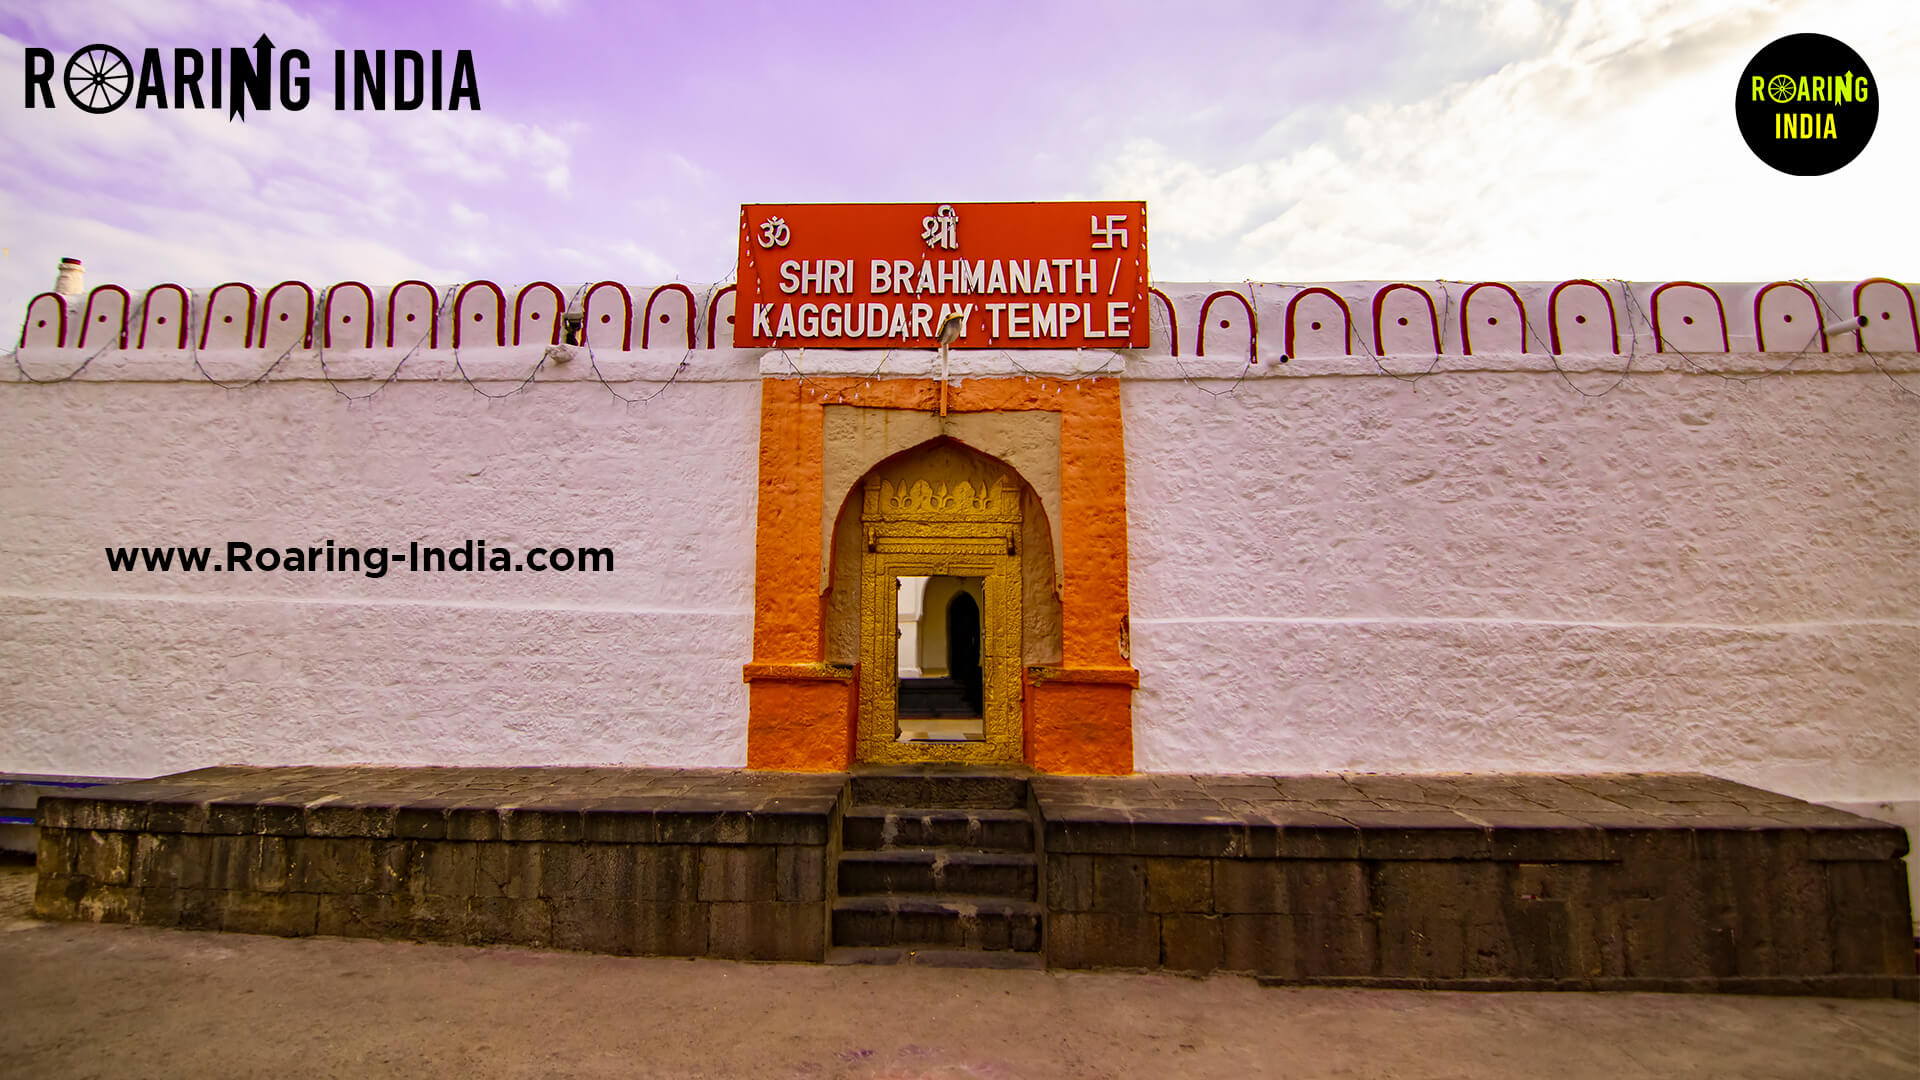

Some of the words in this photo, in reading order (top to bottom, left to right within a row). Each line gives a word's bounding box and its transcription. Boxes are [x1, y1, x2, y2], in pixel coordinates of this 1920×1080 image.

[921, 205, 959, 249] श्री
[779, 259, 855, 295] SHRI
[870, 259, 1098, 295] BRAHMANATH
[985, 302, 1131, 338] TEMPLE
